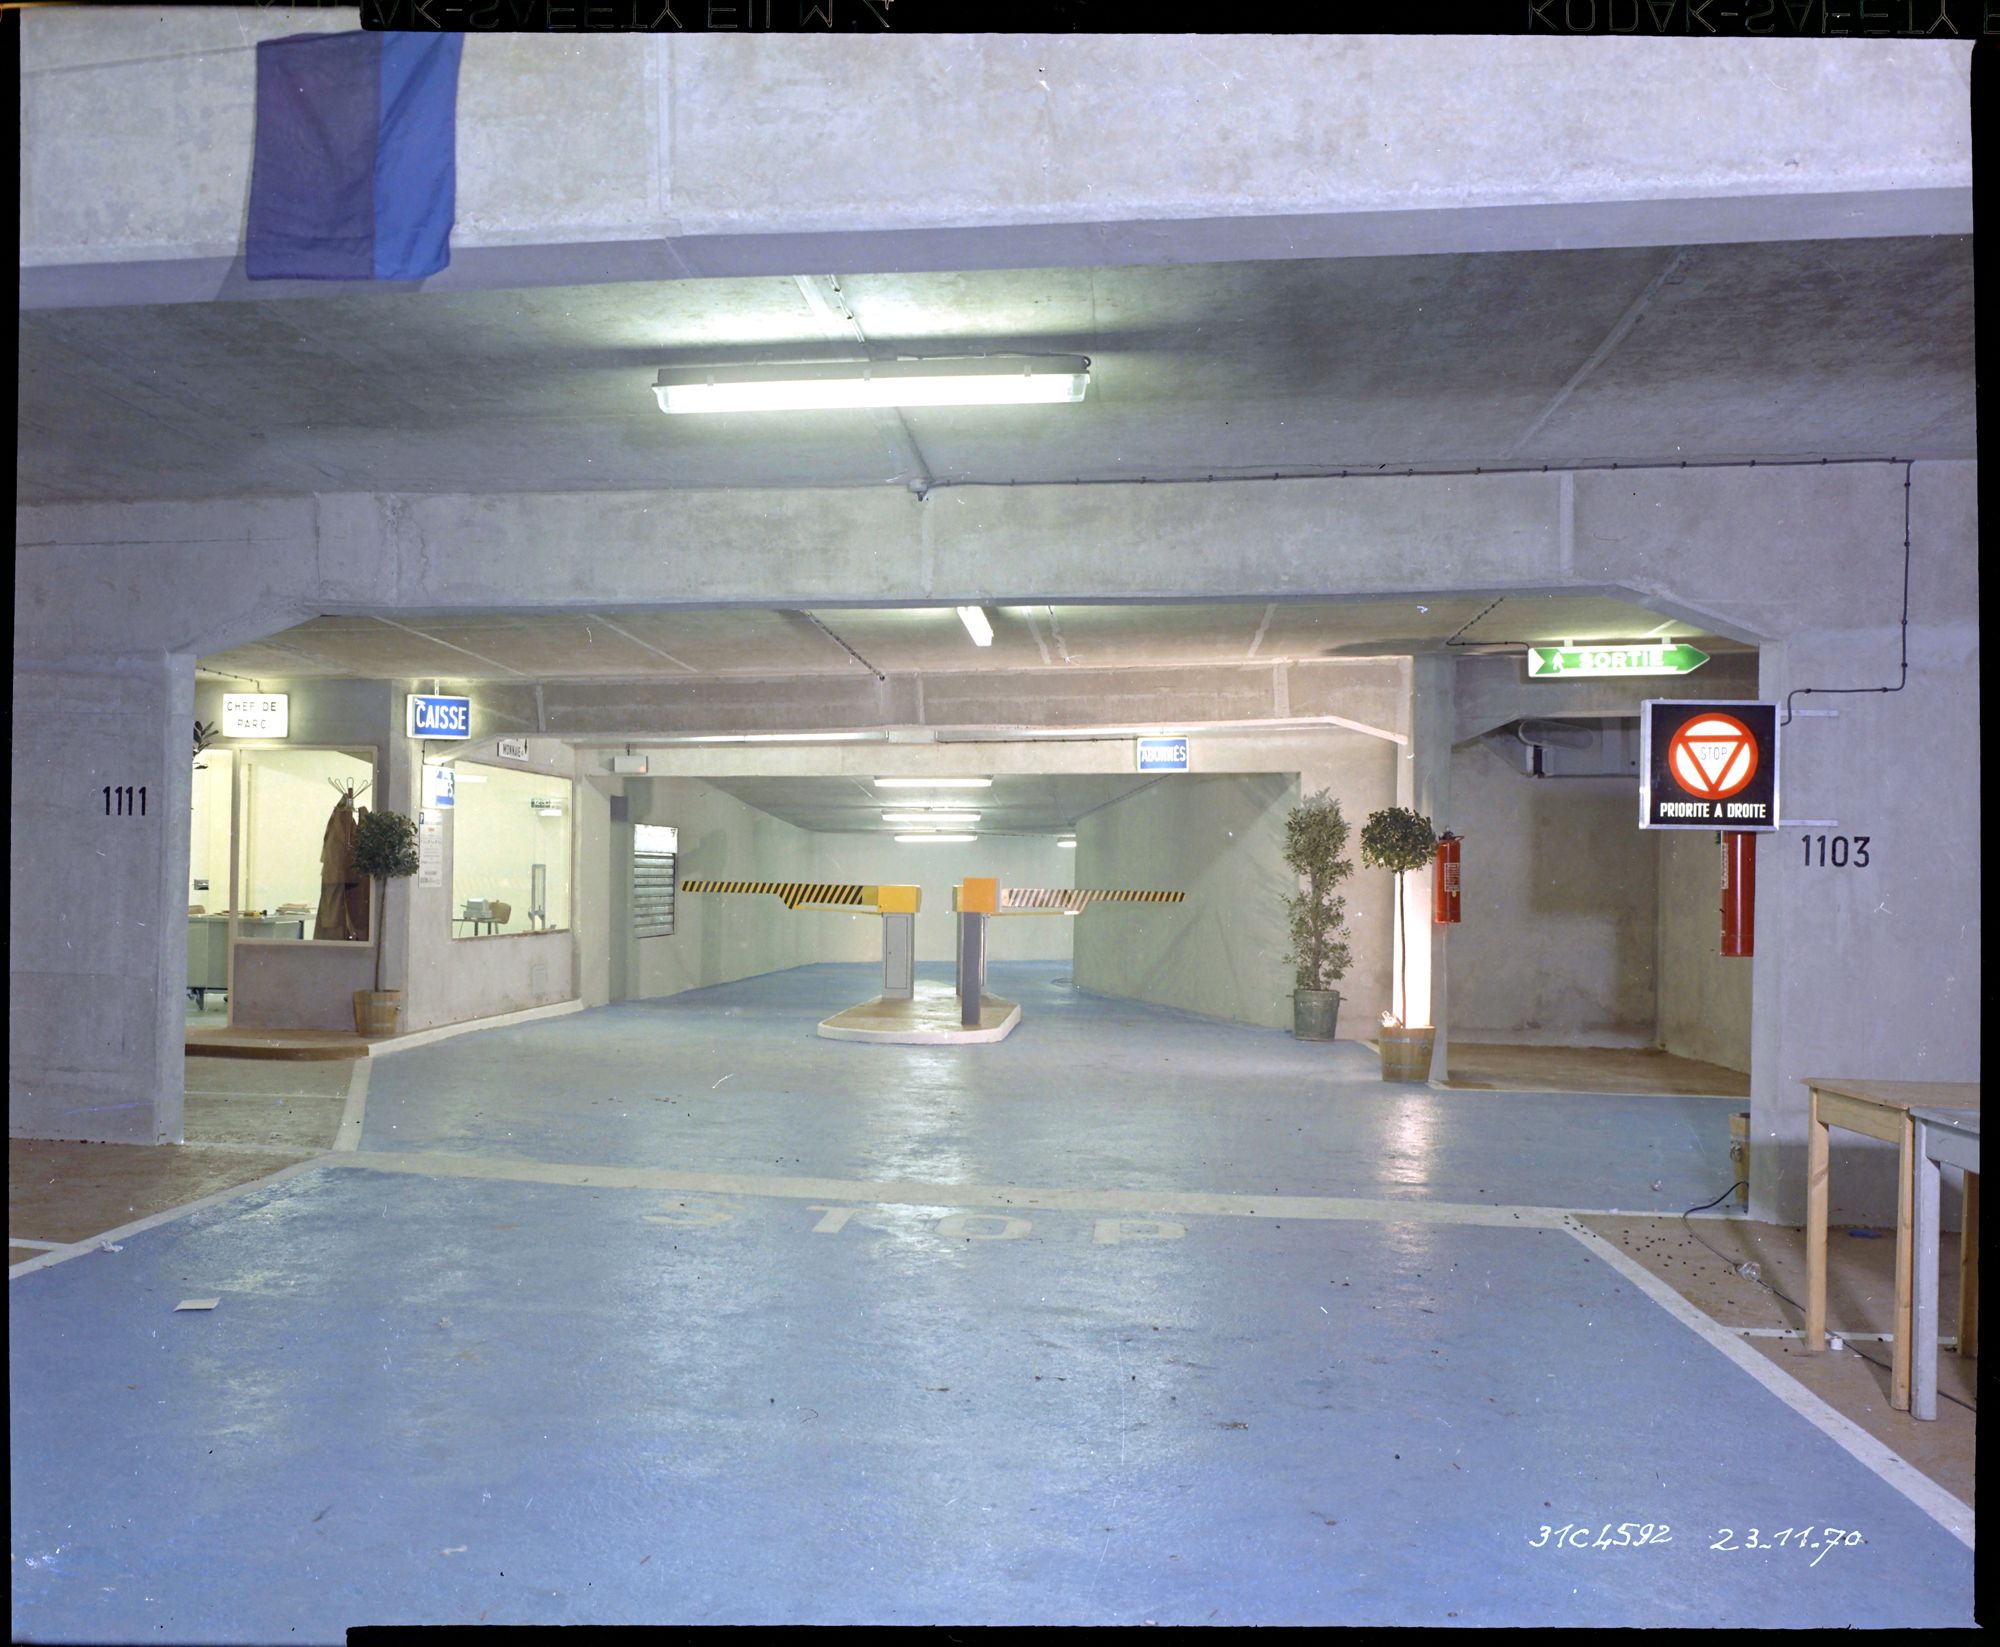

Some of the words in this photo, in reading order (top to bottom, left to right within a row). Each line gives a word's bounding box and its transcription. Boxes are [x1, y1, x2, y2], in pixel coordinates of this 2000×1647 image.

[1579, 650, 1664, 669] SORTIE
[227, 701, 256, 712] CHEF
[262, 701, 277, 712] DE
[237, 719, 267, 729] PARC
[416, 704, 467, 730] CAISSE
[1700, 746, 1728, 761] STOP
[102, 786, 147, 816] 1111
[1660, 802, 1710, 818] PRIORITE
[1714, 803, 1723, 818] A
[1727, 803, 1767, 819] DROITE
[1801, 834, 1871, 868] 1103
[640, 1201, 1187, 1245] STOP
